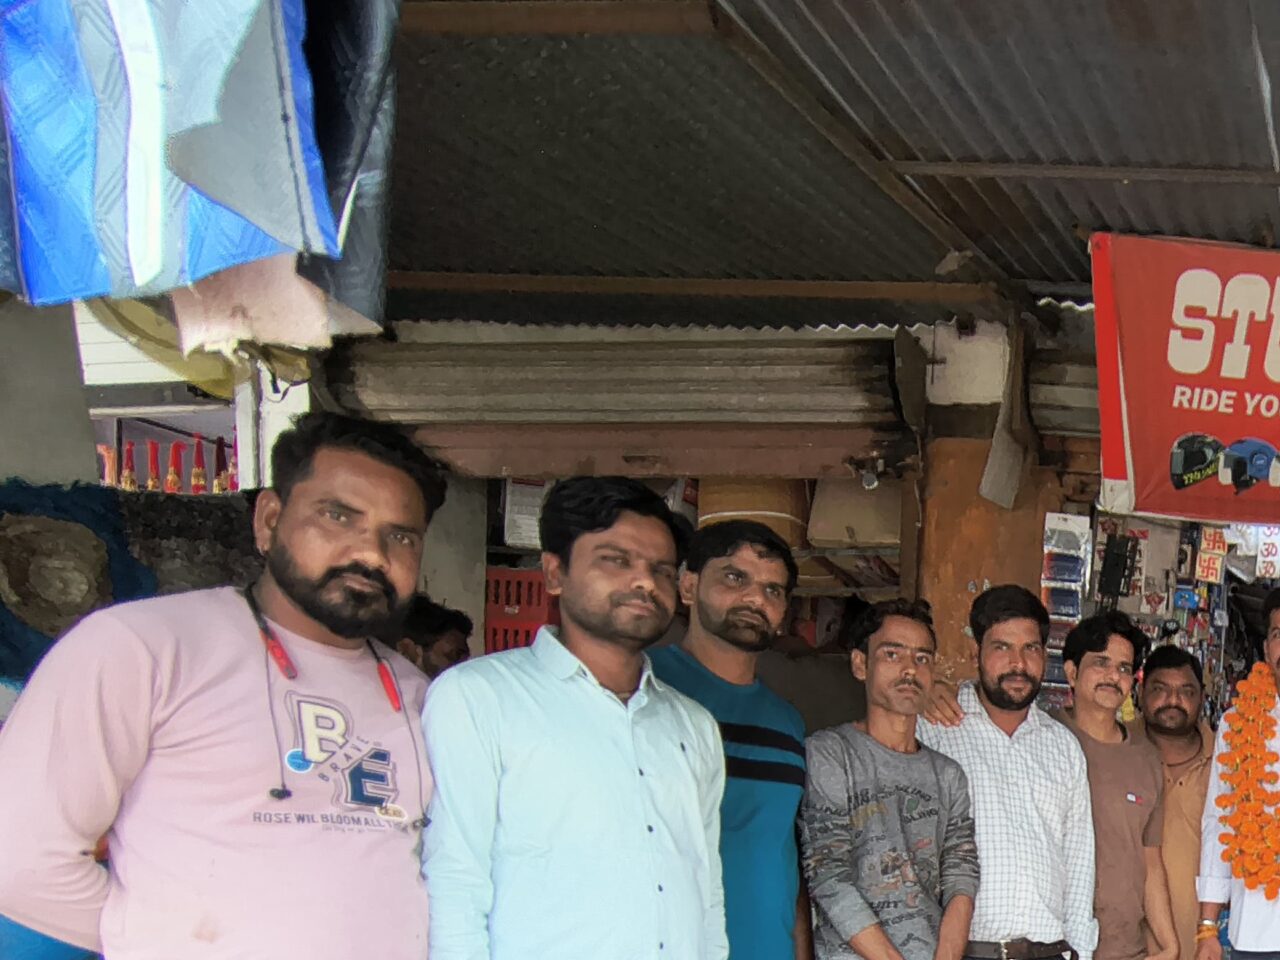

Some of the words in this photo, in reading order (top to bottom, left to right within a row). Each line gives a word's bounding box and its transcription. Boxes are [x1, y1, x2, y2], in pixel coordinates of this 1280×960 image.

[1173, 386, 1237, 414] RIDE
[252, 811, 292, 824] ROSE
[320, 813, 362, 827] BLOOM
